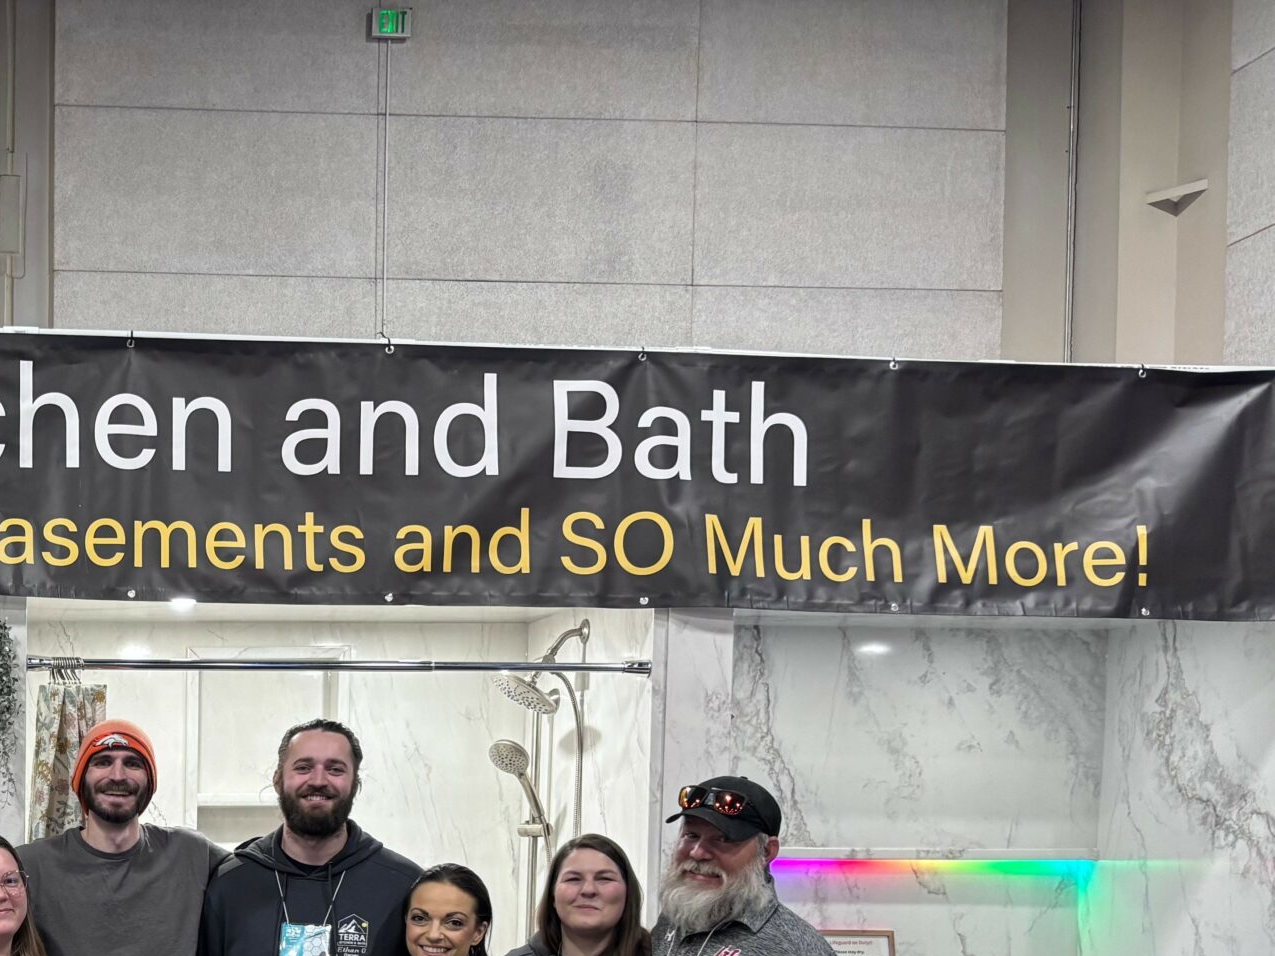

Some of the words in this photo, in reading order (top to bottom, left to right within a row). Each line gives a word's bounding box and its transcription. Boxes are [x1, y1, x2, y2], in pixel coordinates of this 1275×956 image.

[379, 9, 407, 33] EXIT
[281, 372, 499, 479] and
[553, 380, 808, 488] Bath
[396, 509, 531, 575] and
[561, 511, 674, 577] SO
[707, 516, 904, 584] Much
[933, 523, 1150, 588] More!
[338, 933, 366, 942] TERRA
